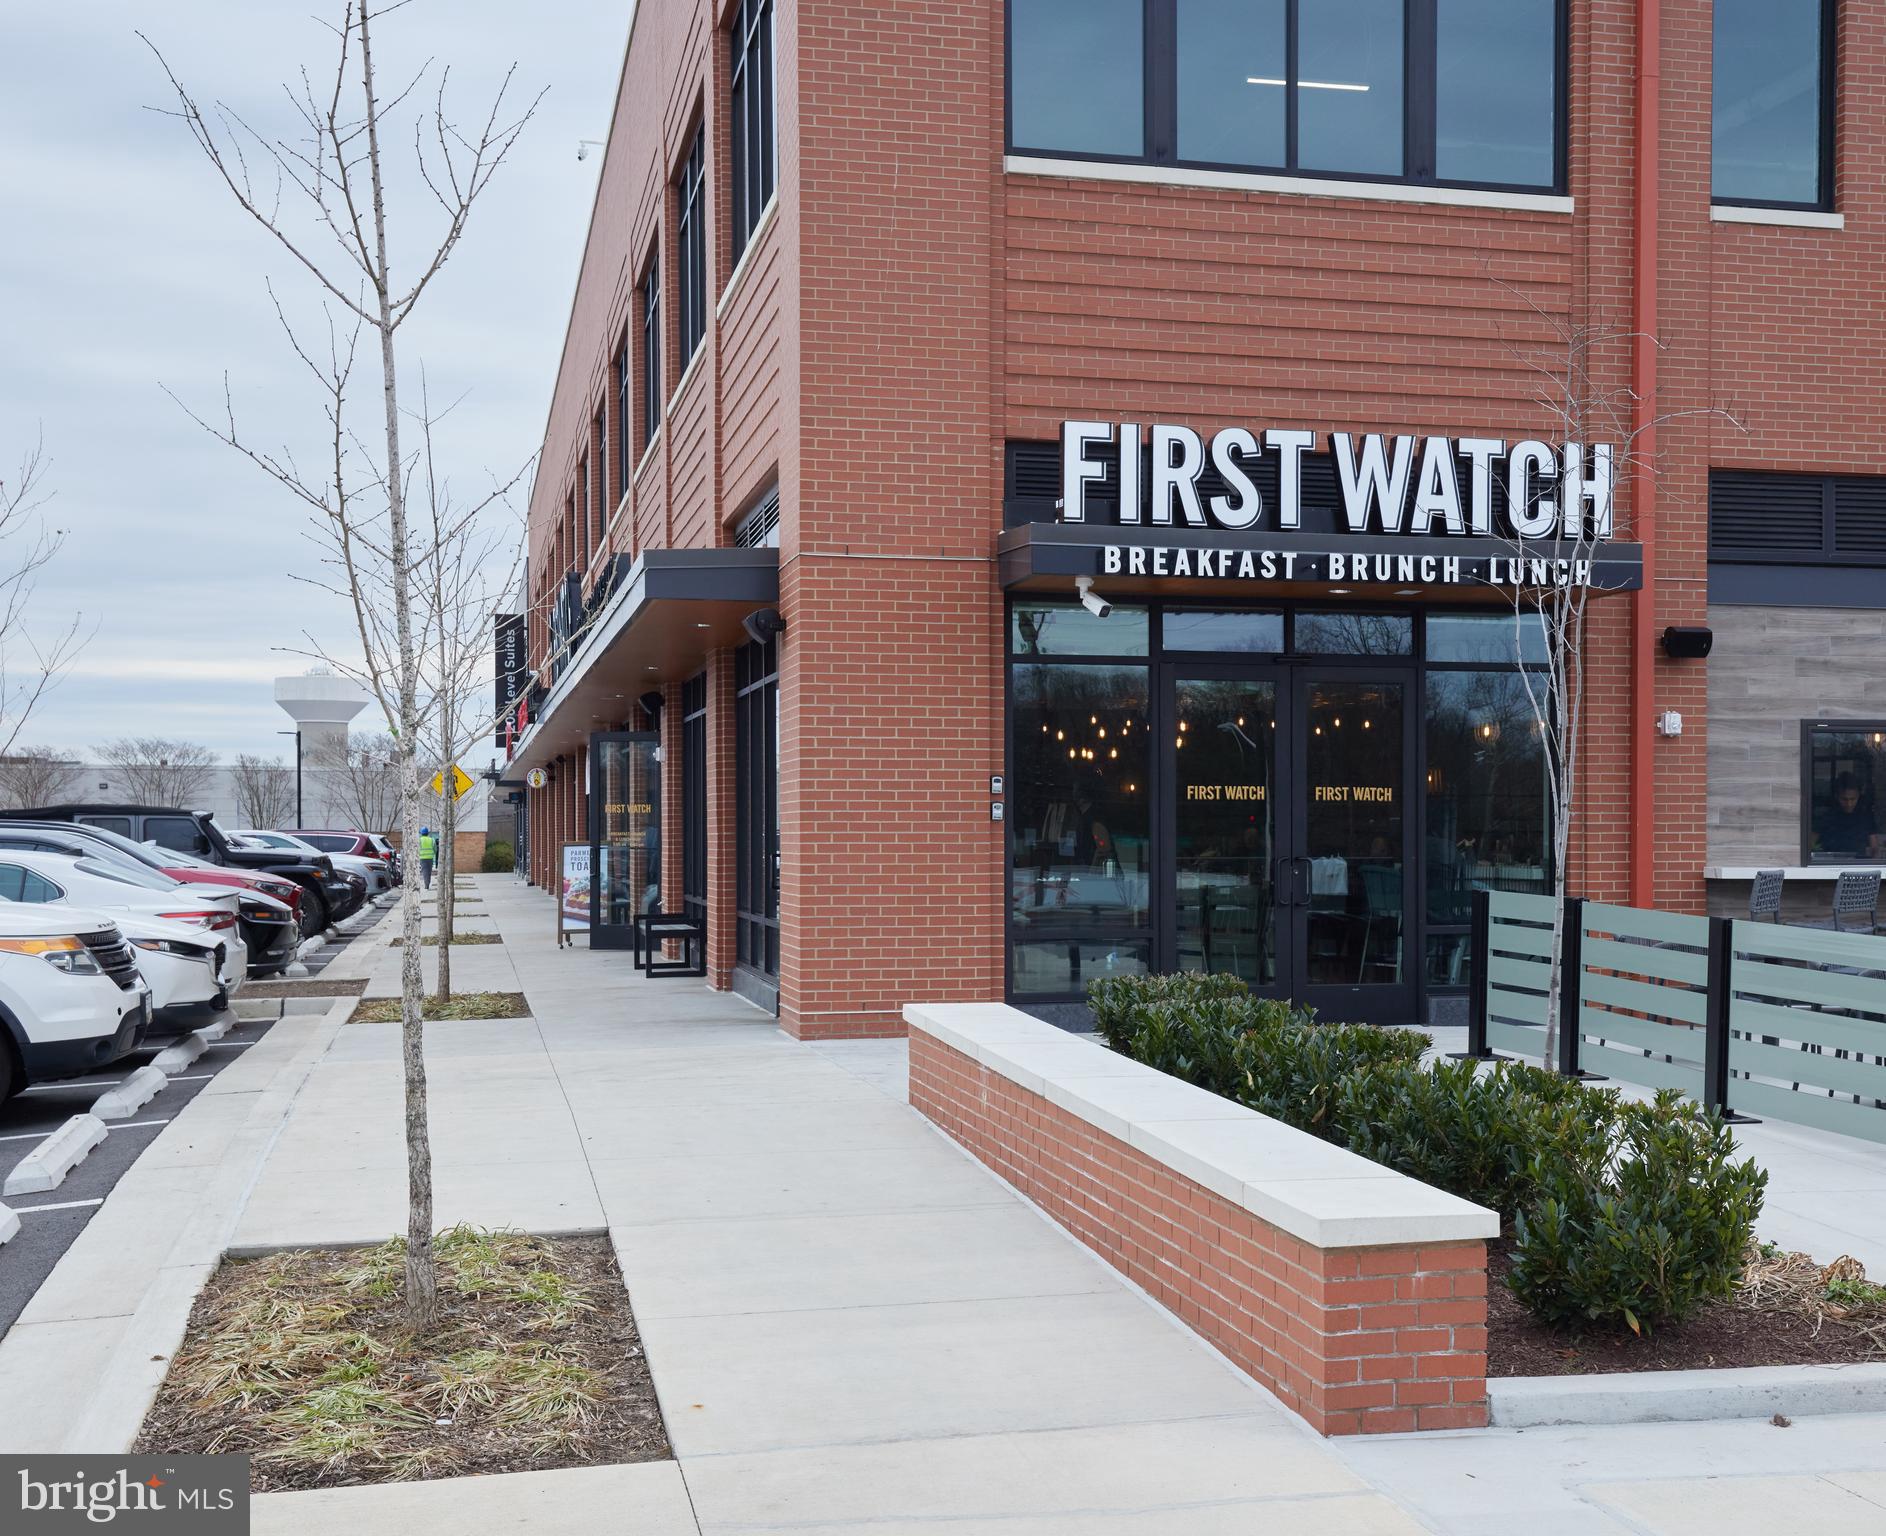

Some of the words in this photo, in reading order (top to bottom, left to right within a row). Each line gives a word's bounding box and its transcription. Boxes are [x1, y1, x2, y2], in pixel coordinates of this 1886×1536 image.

[1062, 421, 1316, 529] FIRST
[1330, 432, 1614, 540] WATCH
[1104, 545, 1298, 580] BREAKFAST
[1329, 553, 1460, 583] BRUNCH
[1490, 557, 1592, 586] LUNCH
[505, 629, 516, 669] Suites
[1186, 785, 1222, 801] FIRST
[1225, 786, 1265, 801] WATCH
[1315, 786, 1350, 801] FIRST
[1353, 786, 1393, 802] WATCH
[605, 804, 626, 813] FIRST
[627, 804, 651, 813] WATCH
